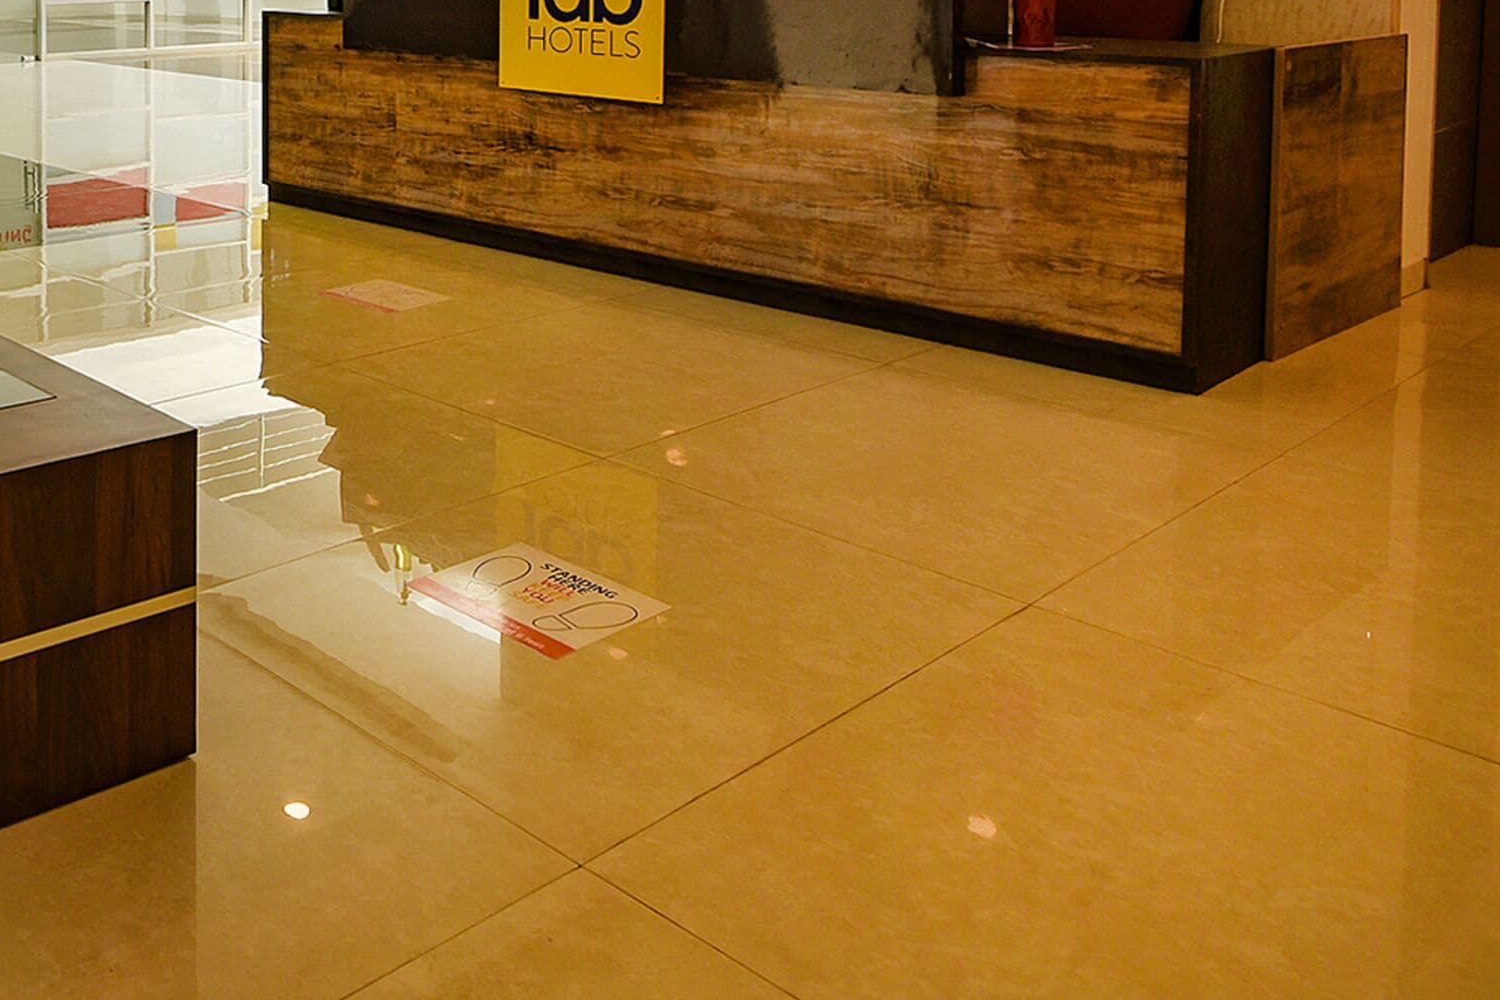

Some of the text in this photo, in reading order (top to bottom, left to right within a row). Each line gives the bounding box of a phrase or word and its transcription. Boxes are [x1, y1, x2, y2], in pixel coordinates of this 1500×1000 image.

[528, 26, 641, 58] HOTELS
[540, 563, 619, 599] STANDING
[540, 579, 577, 597] WILL
[548, 574, 591, 595] HERE
[522, 586, 555, 604] YOU
